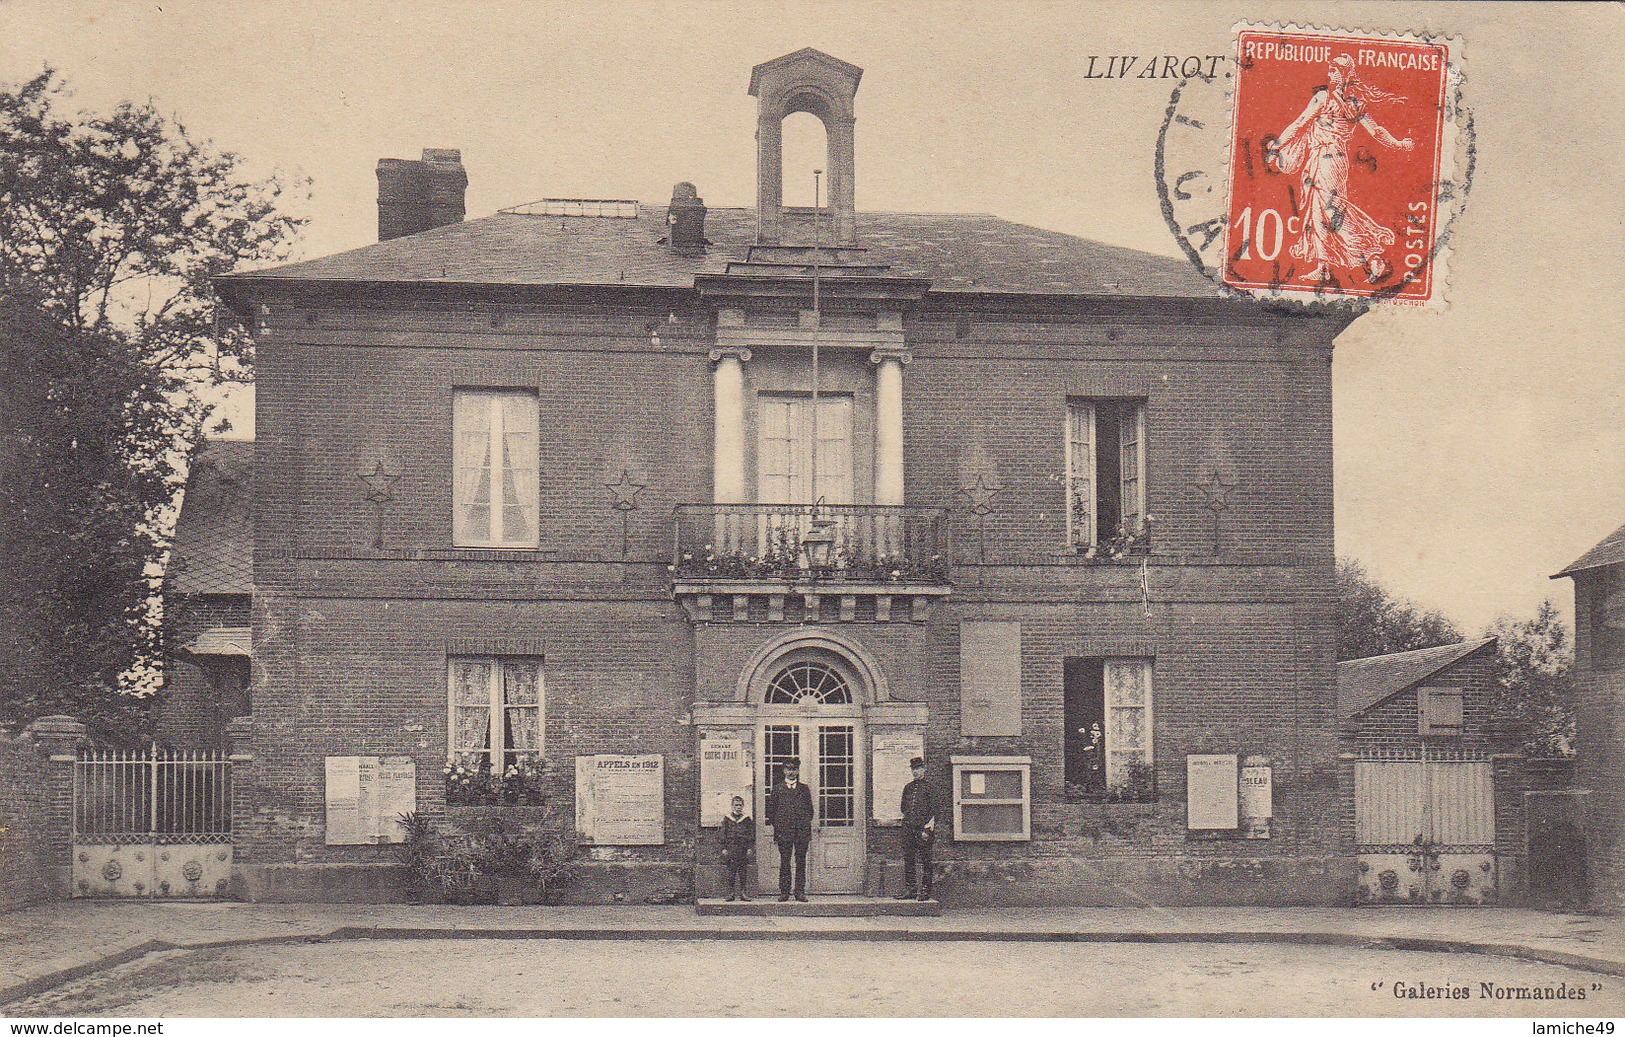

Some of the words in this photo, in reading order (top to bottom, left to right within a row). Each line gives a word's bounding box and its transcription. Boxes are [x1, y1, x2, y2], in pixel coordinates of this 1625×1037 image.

[1358, 49, 1439, 71] FRANÇAISE
[1404, 201, 1428, 283] POSTES
[597, 760, 631, 769] APPELS
[642, 760, 659, 769] 1912
